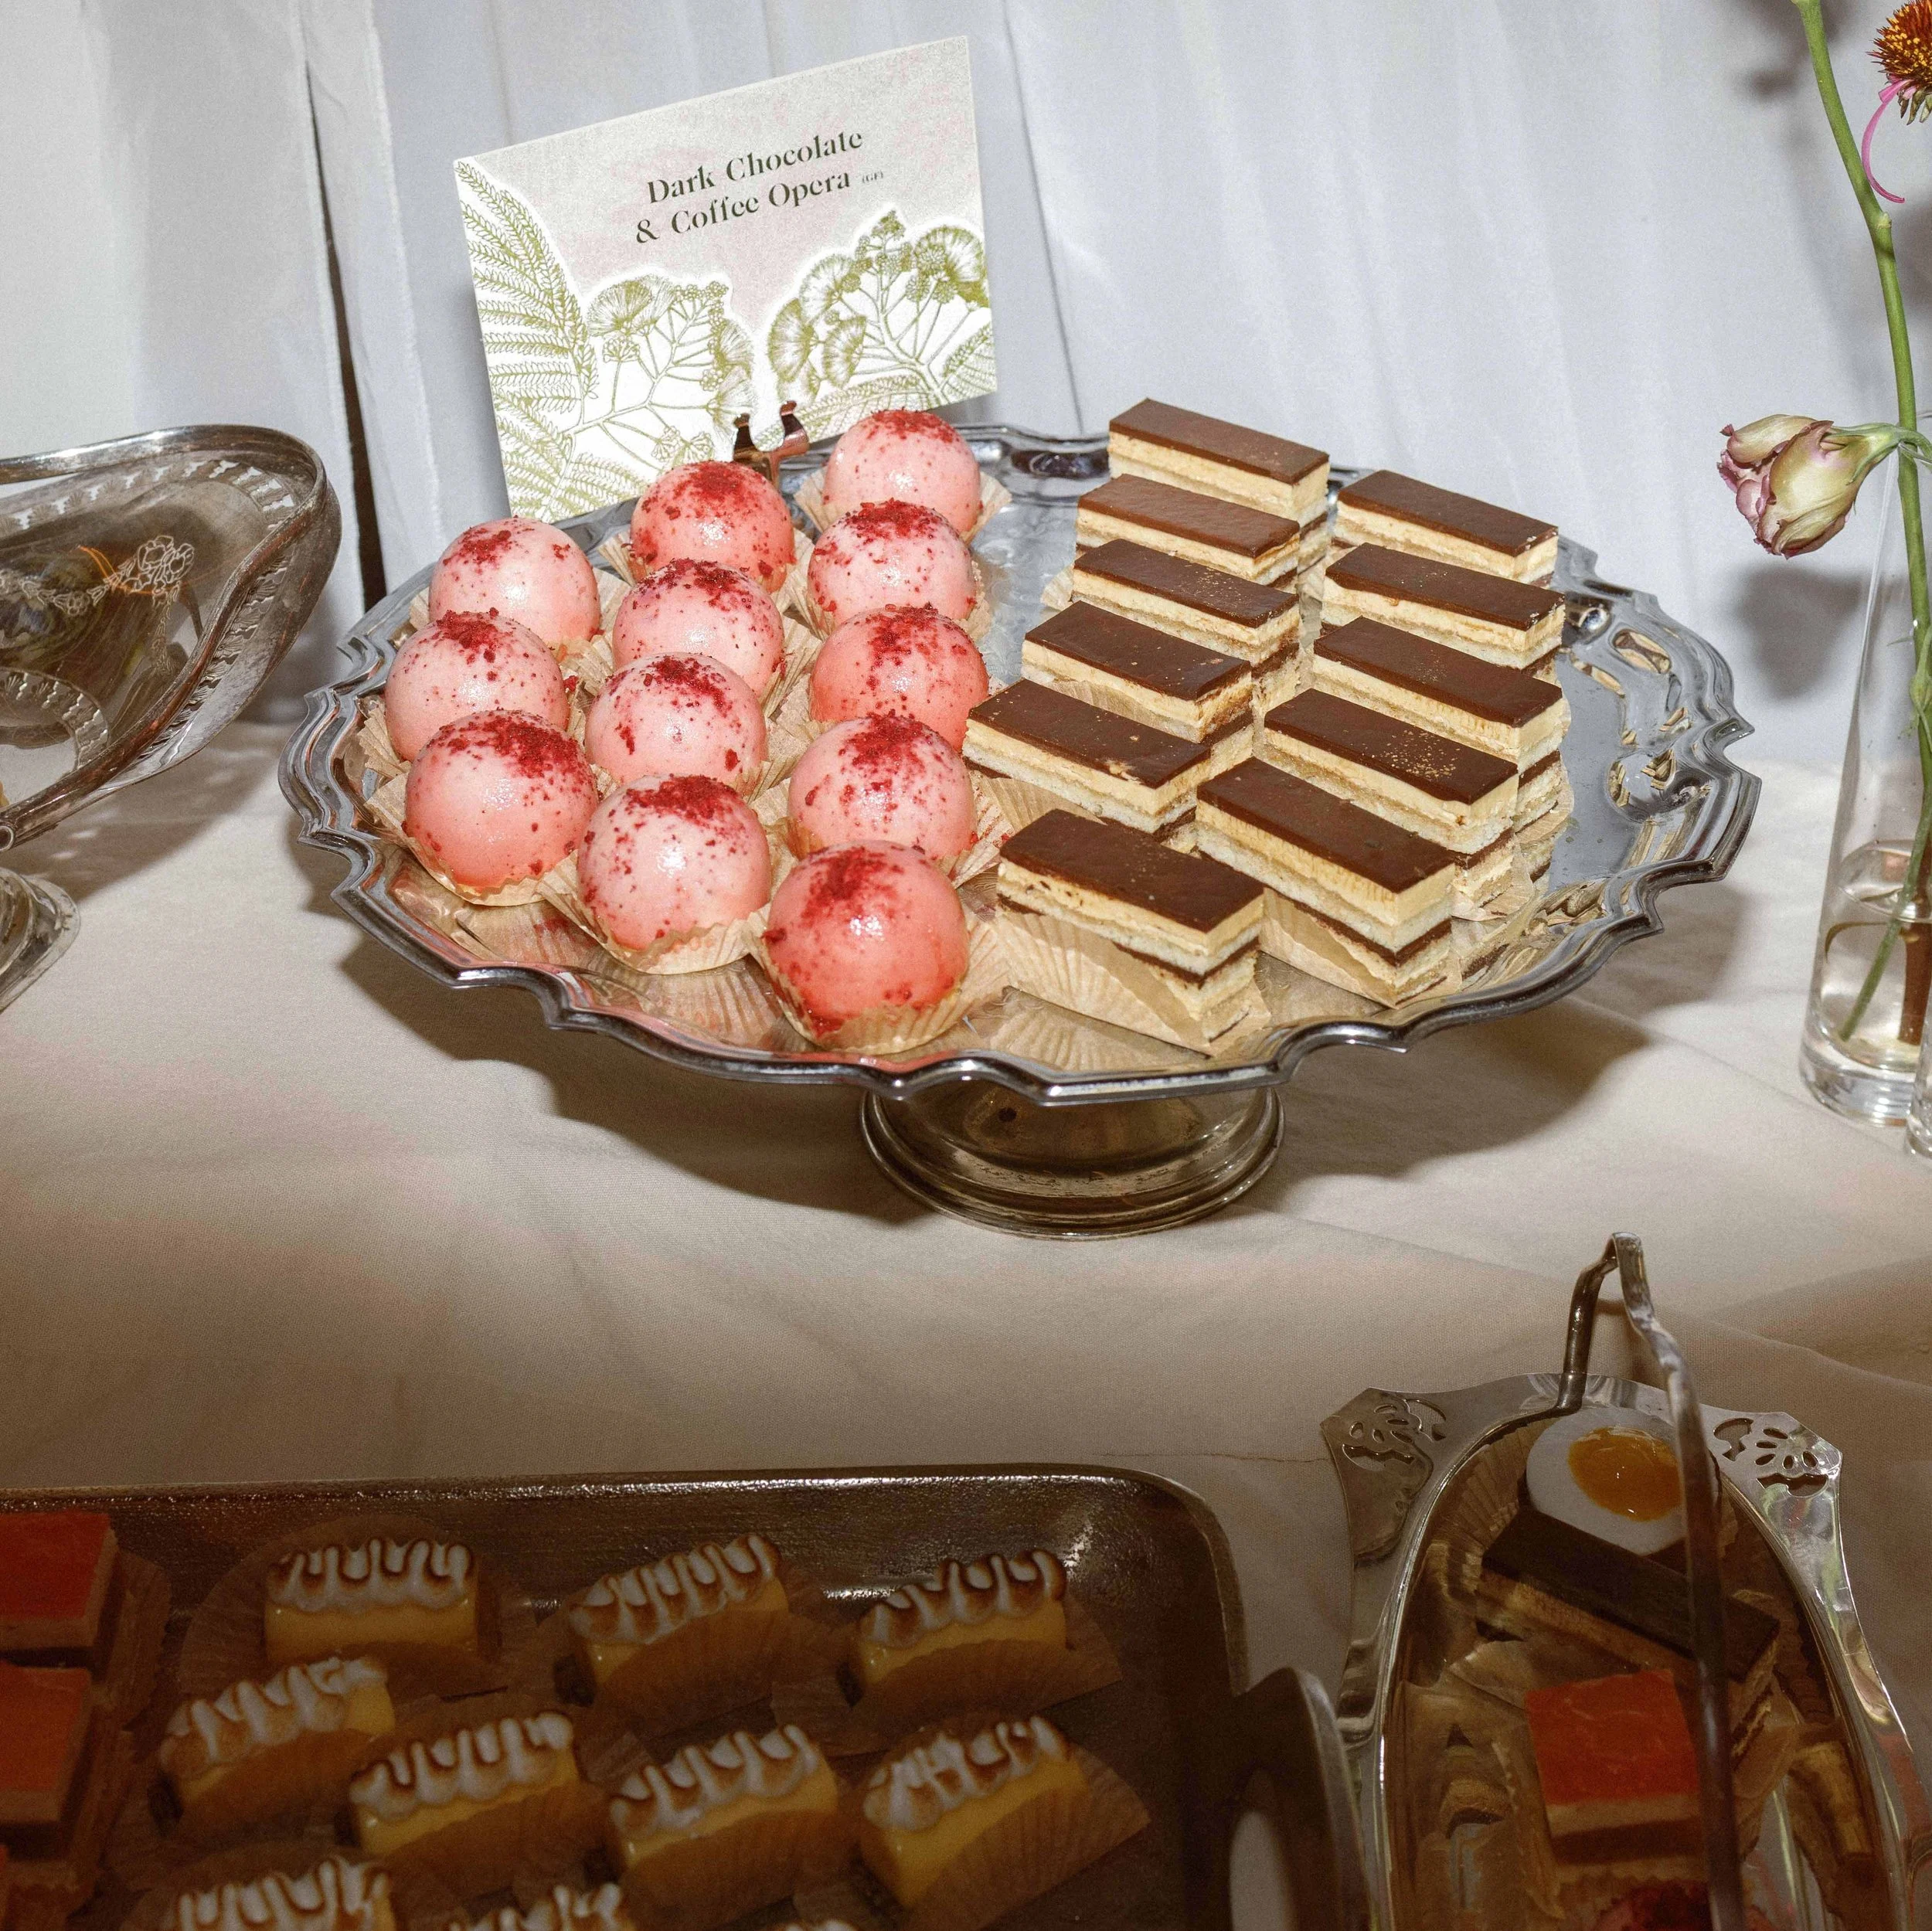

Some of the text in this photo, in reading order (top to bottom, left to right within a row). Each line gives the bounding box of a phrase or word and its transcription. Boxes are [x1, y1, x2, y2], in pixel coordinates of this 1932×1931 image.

[648, 131, 863, 203] Dark Chocolate
[636, 219, 660, 243] &
[672, 195, 759, 234] Coffee
[769, 172, 851, 207] Opera
